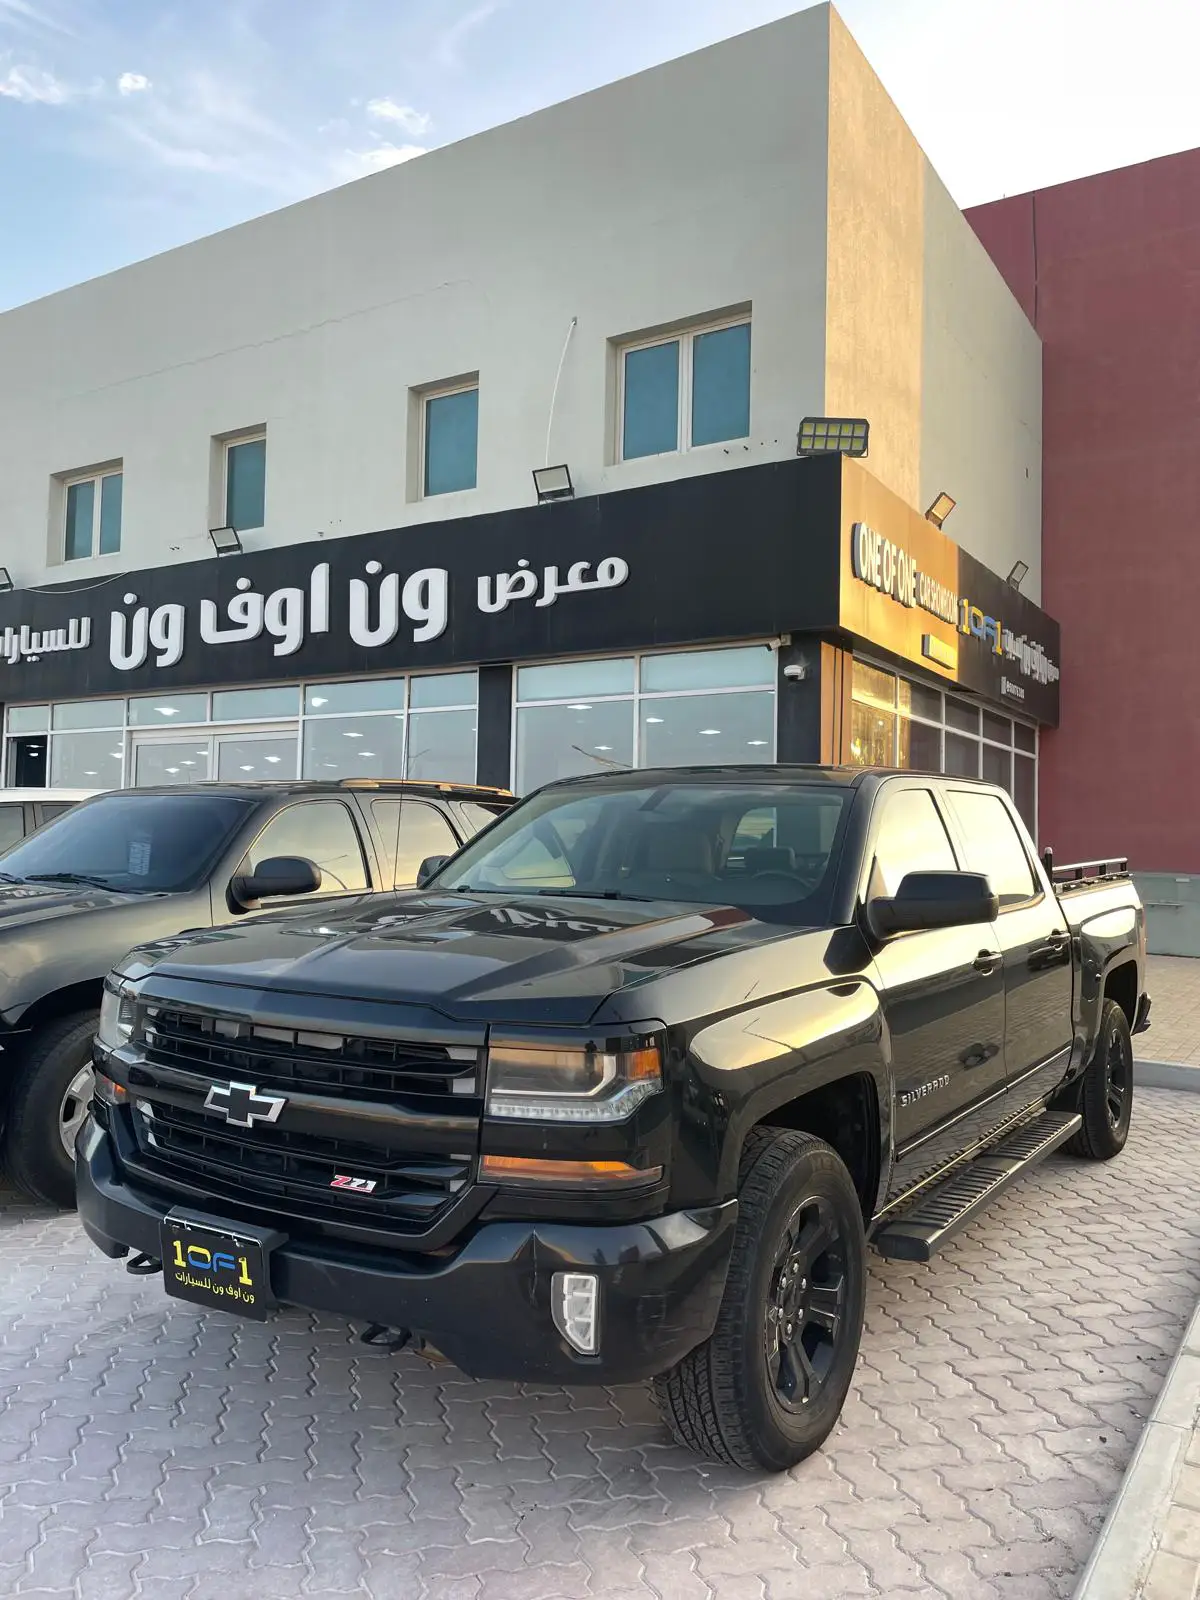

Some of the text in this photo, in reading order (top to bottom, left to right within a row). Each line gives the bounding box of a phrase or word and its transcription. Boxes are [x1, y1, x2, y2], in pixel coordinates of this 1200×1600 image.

[853, 522, 881, 587] ONE
[881, 538, 898, 596] OF
[896, 550, 917, 608] ONE
[0, 556, 629, 671] معرض ون اوف ون للسيارا
[900, 1074, 950, 1107] SILVERADO
[329, 1174, 377, 1193] Z71
[172, 1240, 253, 1287] 1OF1
[175, 1271, 211, 1289] للسيارات
[212, 1283, 224, 1295] ون
[242, 1291, 255, 1304] ون
